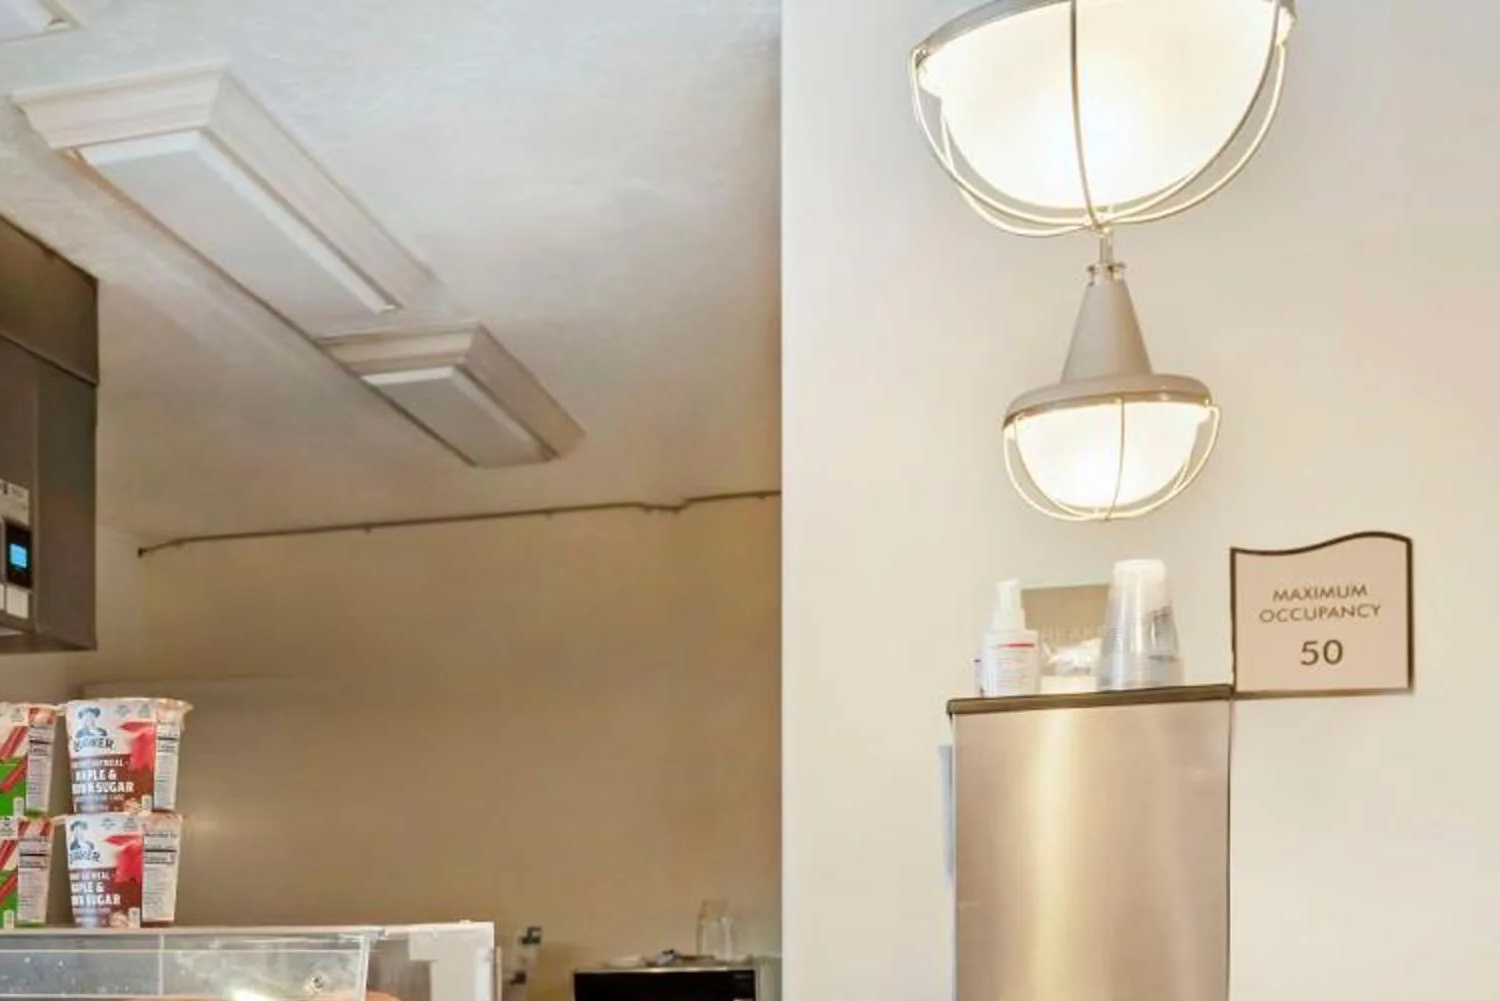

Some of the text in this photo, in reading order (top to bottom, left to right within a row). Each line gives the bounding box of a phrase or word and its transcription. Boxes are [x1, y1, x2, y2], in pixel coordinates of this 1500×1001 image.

[1272, 583, 1368, 602] MAXIMUM
[1259, 603, 1381, 624] OCCUPANCY
[1300, 639, 1344, 666] 50
[95, 781, 135, 794] SUGAR
